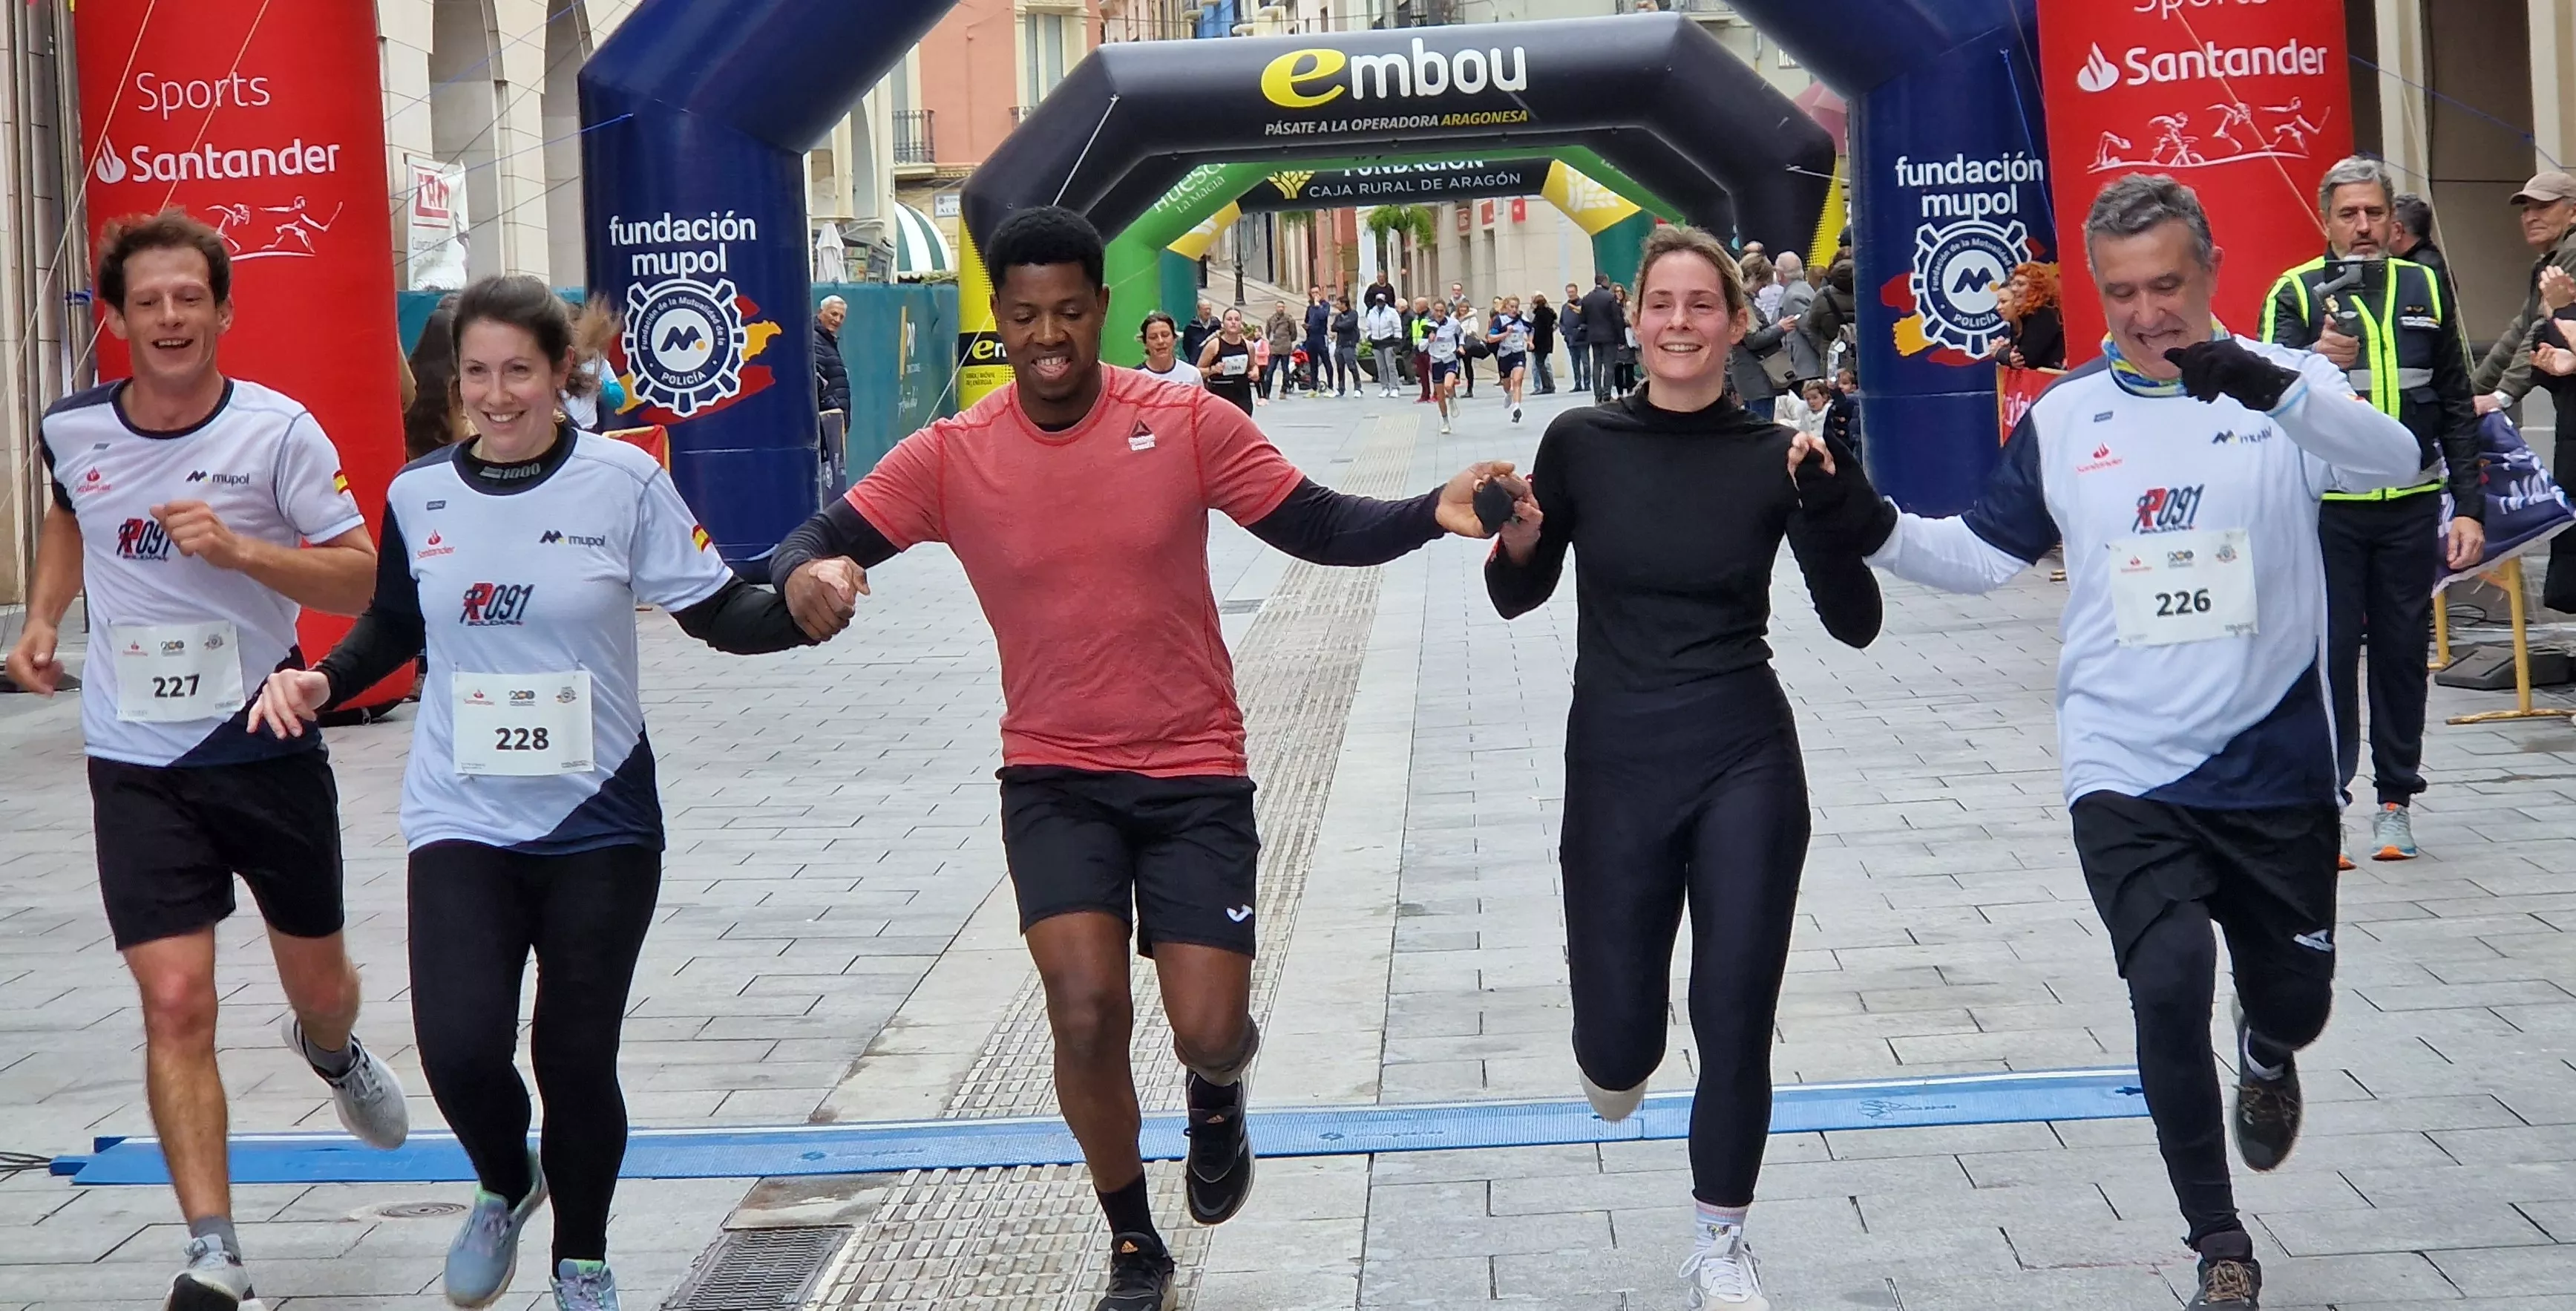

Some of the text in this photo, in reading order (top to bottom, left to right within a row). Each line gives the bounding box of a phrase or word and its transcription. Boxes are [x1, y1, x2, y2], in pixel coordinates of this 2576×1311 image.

[1261, 37, 1527, 108] embou
[2125, 38, 2327, 85] Santander
[137, 72, 270, 120] Sports
[1265, 110, 1528, 136] PÁSATE A LA OPERADORA ARAGONESA
[132, 138, 340, 182] Santander
[1895, 151, 2044, 188] fundación
[1309, 171, 1521, 198] CAJA RURAL DE ARAGÓN
[1921, 183, 2018, 220] mupol
[609, 210, 756, 246] fundación
[632, 243, 727, 279] mupol
[1933, 250, 1950, 291] Fundación
[1950, 241, 1961, 252] de
[1962, 238, 1970, 247] la
[641, 297, 726, 350] Fundación de la Mutualidad de la
[1953, 313, 1999, 327] POLICÍA
[661, 371, 707, 385] POLICÍA
[212, 472, 250, 486] mupol
[568, 535, 606, 548] mupol
[2155, 589, 2212, 617] 226
[153, 674, 200, 698] 227
[495, 728, 549, 751] 228
